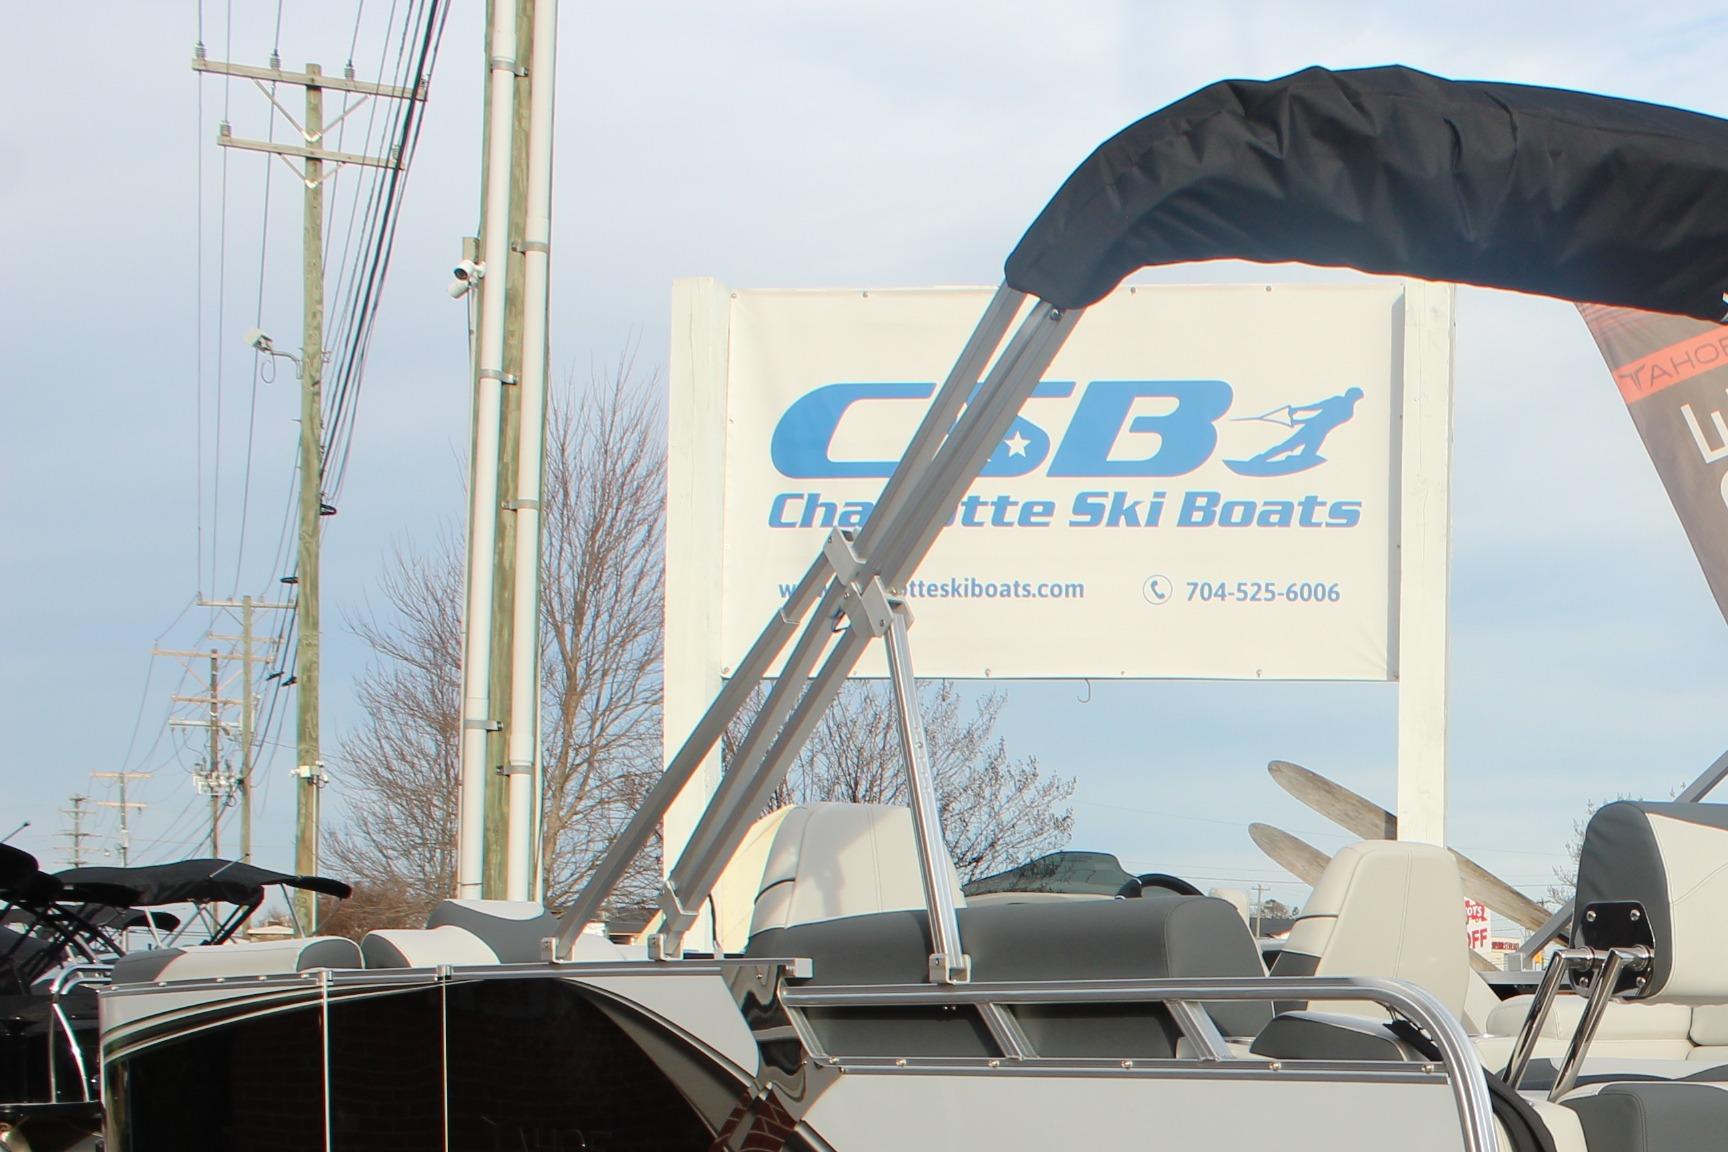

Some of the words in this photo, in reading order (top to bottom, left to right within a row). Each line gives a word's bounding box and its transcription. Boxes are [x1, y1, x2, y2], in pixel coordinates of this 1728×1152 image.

[768, 492, 1056, 528] Chatte
[1068, 491, 1167, 528] Ski
[1176, 491, 1362, 528] Boats
[778, 577, 1085, 599] wtteskiboats.com
[1186, 581, 1341, 602] 704-525-6006
